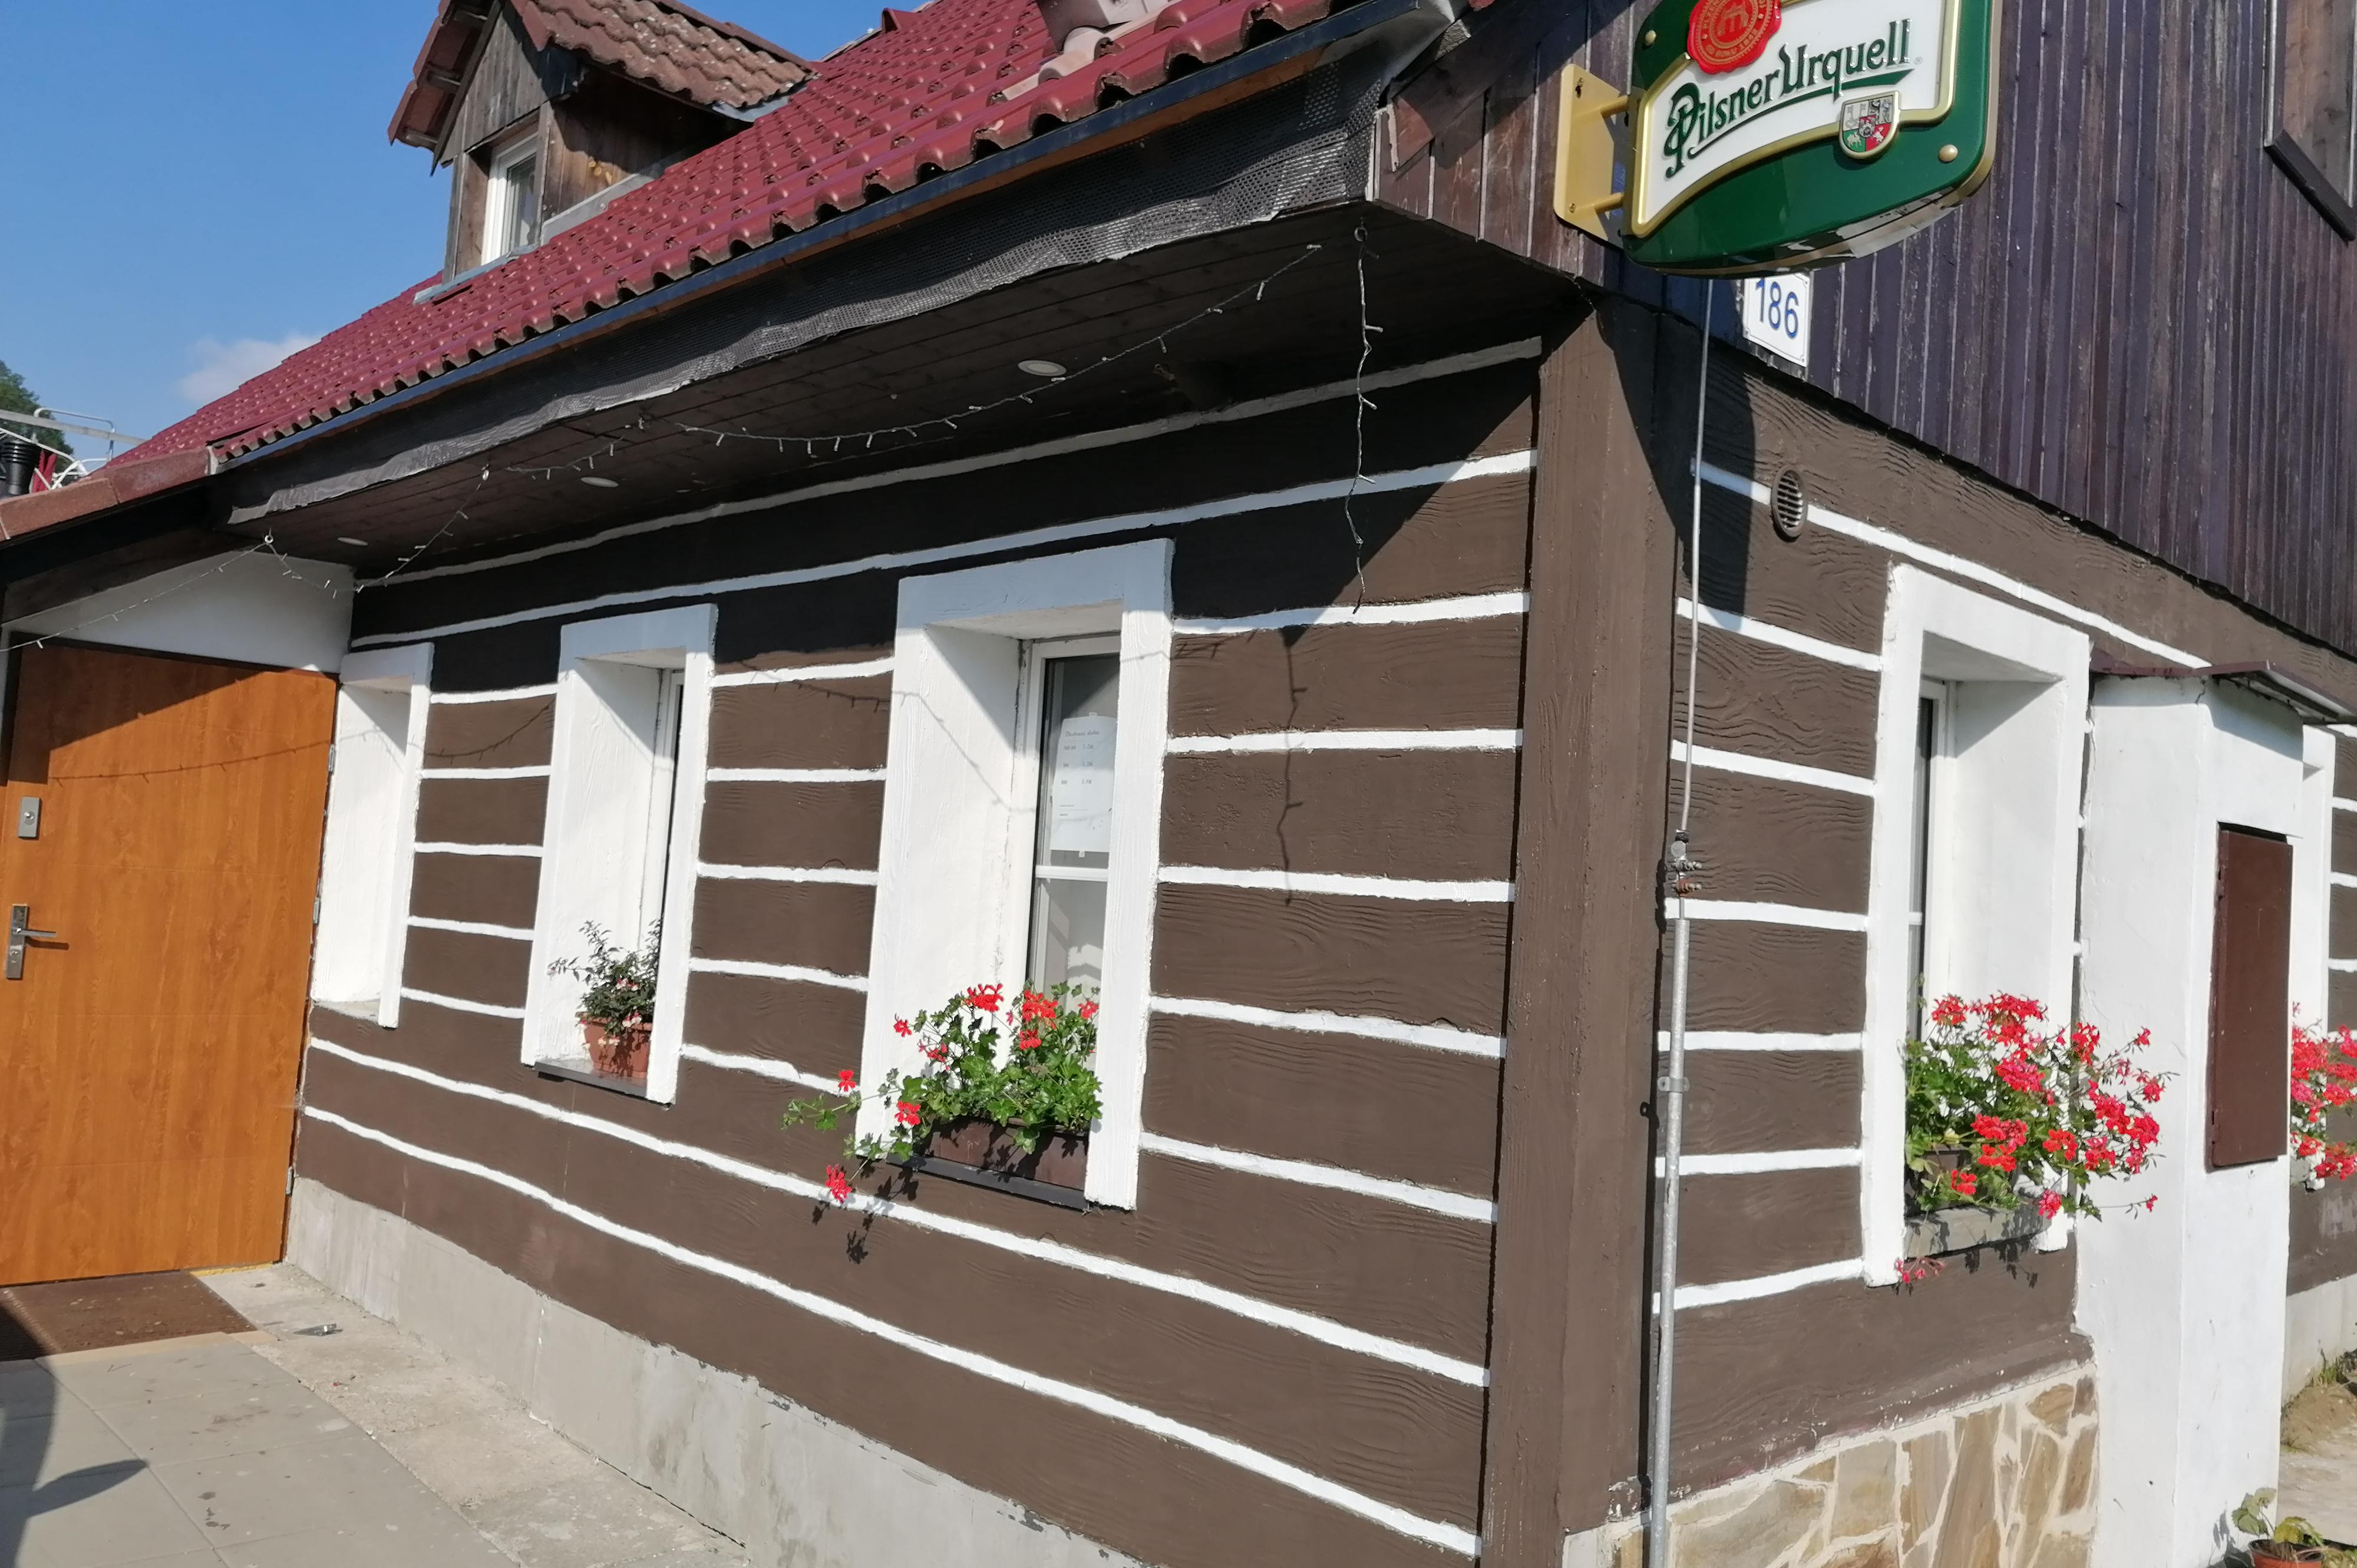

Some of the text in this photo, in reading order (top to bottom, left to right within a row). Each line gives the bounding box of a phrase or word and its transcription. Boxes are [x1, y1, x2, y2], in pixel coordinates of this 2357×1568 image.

[1663, 18, 1913, 179] Pilsner Urquell
[1755, 277, 1799, 339] 186
